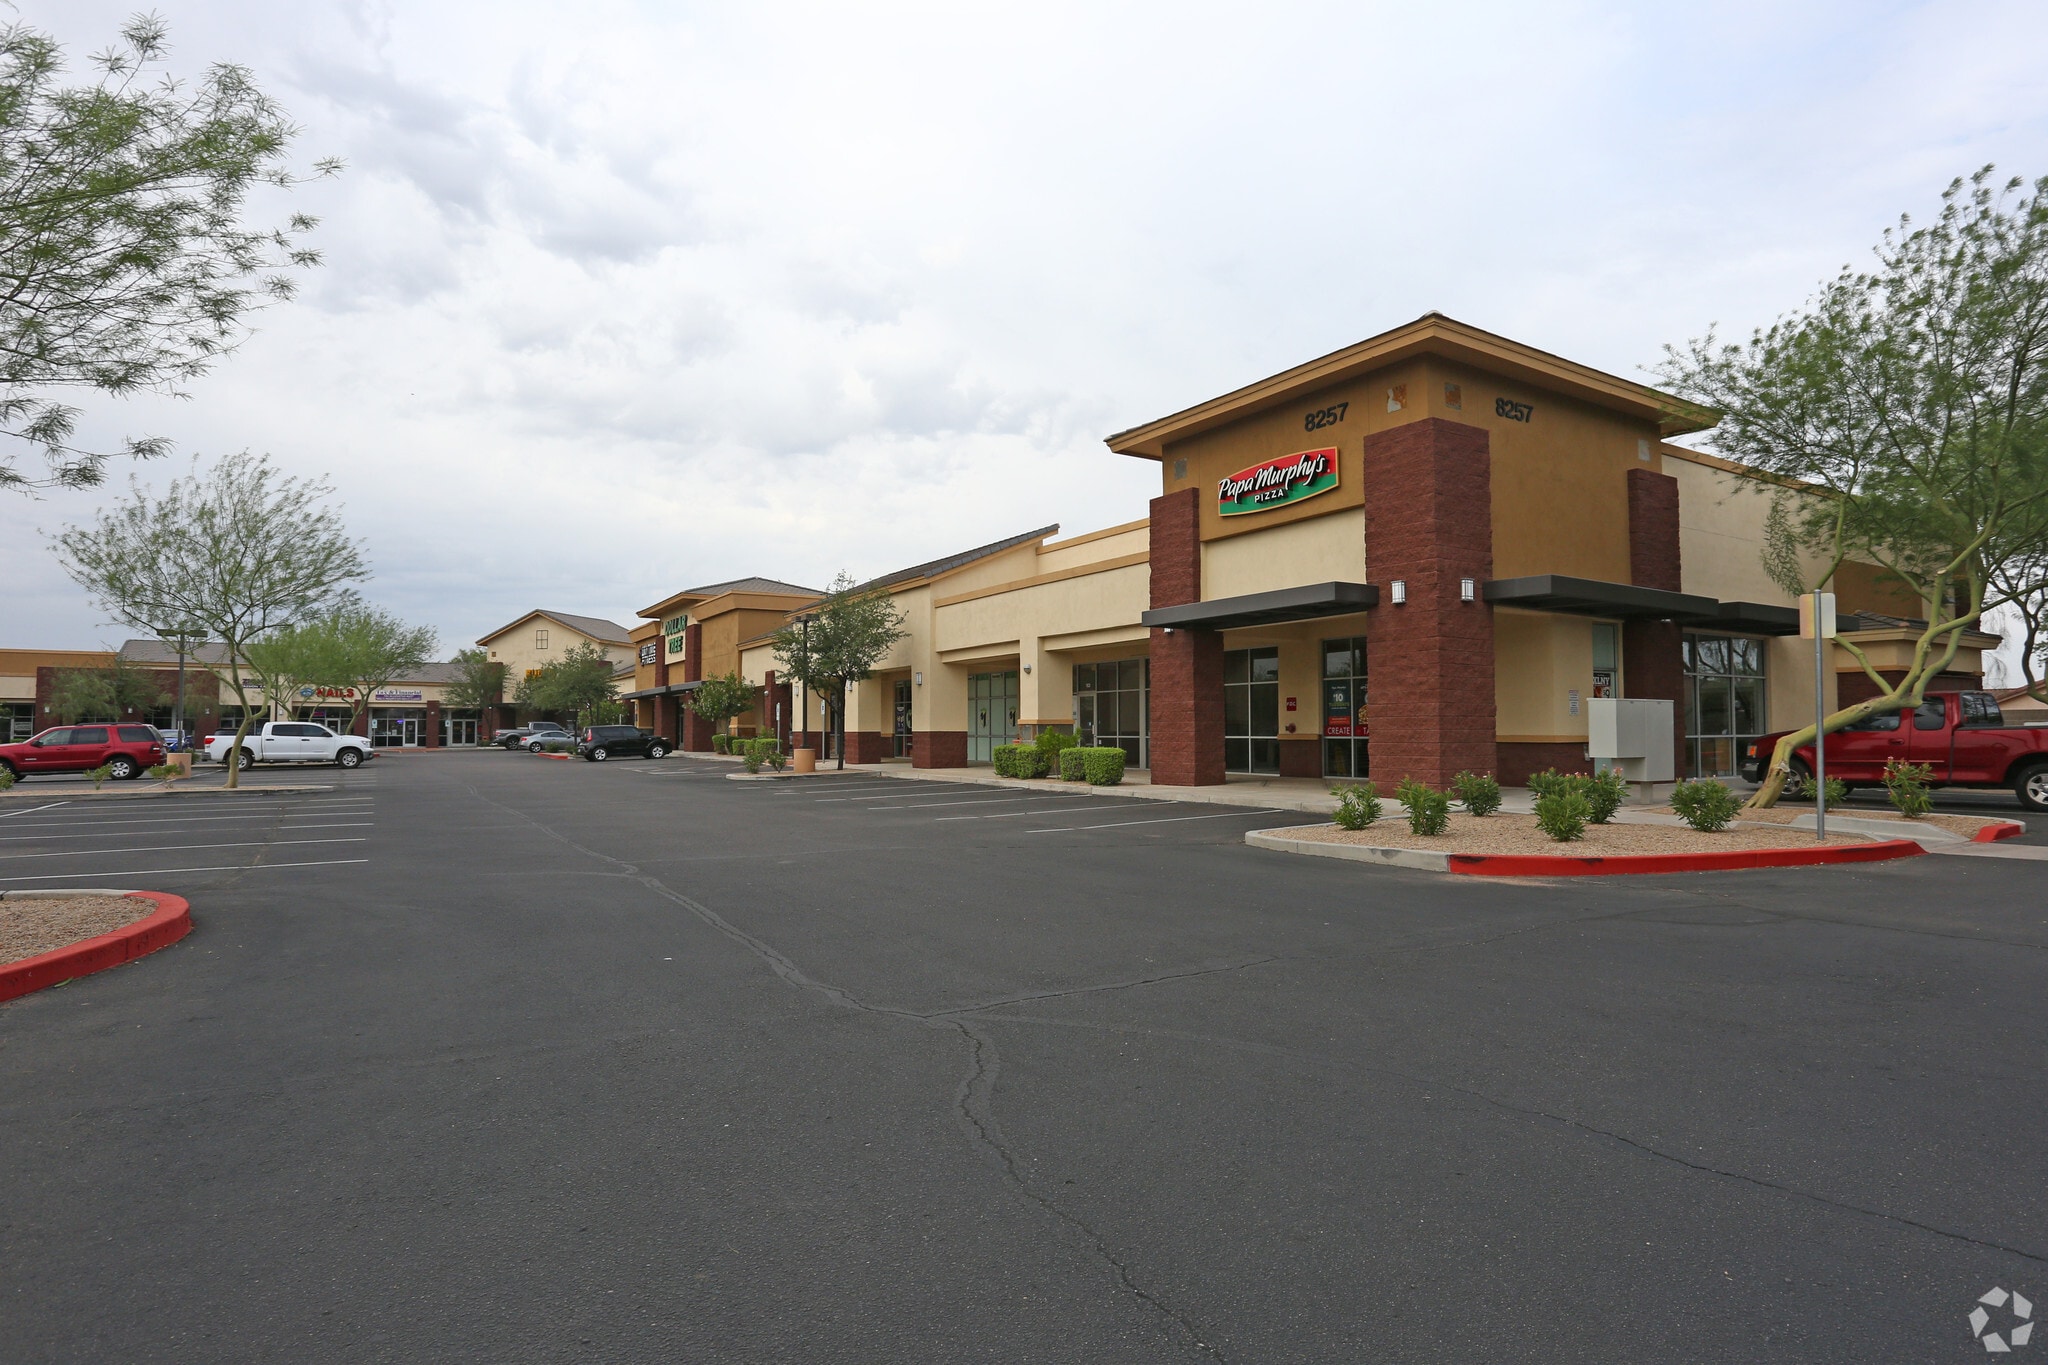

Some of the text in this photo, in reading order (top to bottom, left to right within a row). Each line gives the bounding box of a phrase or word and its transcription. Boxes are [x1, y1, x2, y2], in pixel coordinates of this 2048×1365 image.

[1304, 402, 1349, 432] 8257
[1495, 397, 1534, 424] 8257
[1218, 454, 1326, 504] Papa Murphy's
[1254, 488, 1285, 504] PIZZA
[665, 614, 688, 637] DOLLAR
[668, 635, 684, 655] TREE
[316, 687, 355, 698] NAILS
[1327, 727, 1351, 735] CREATE
